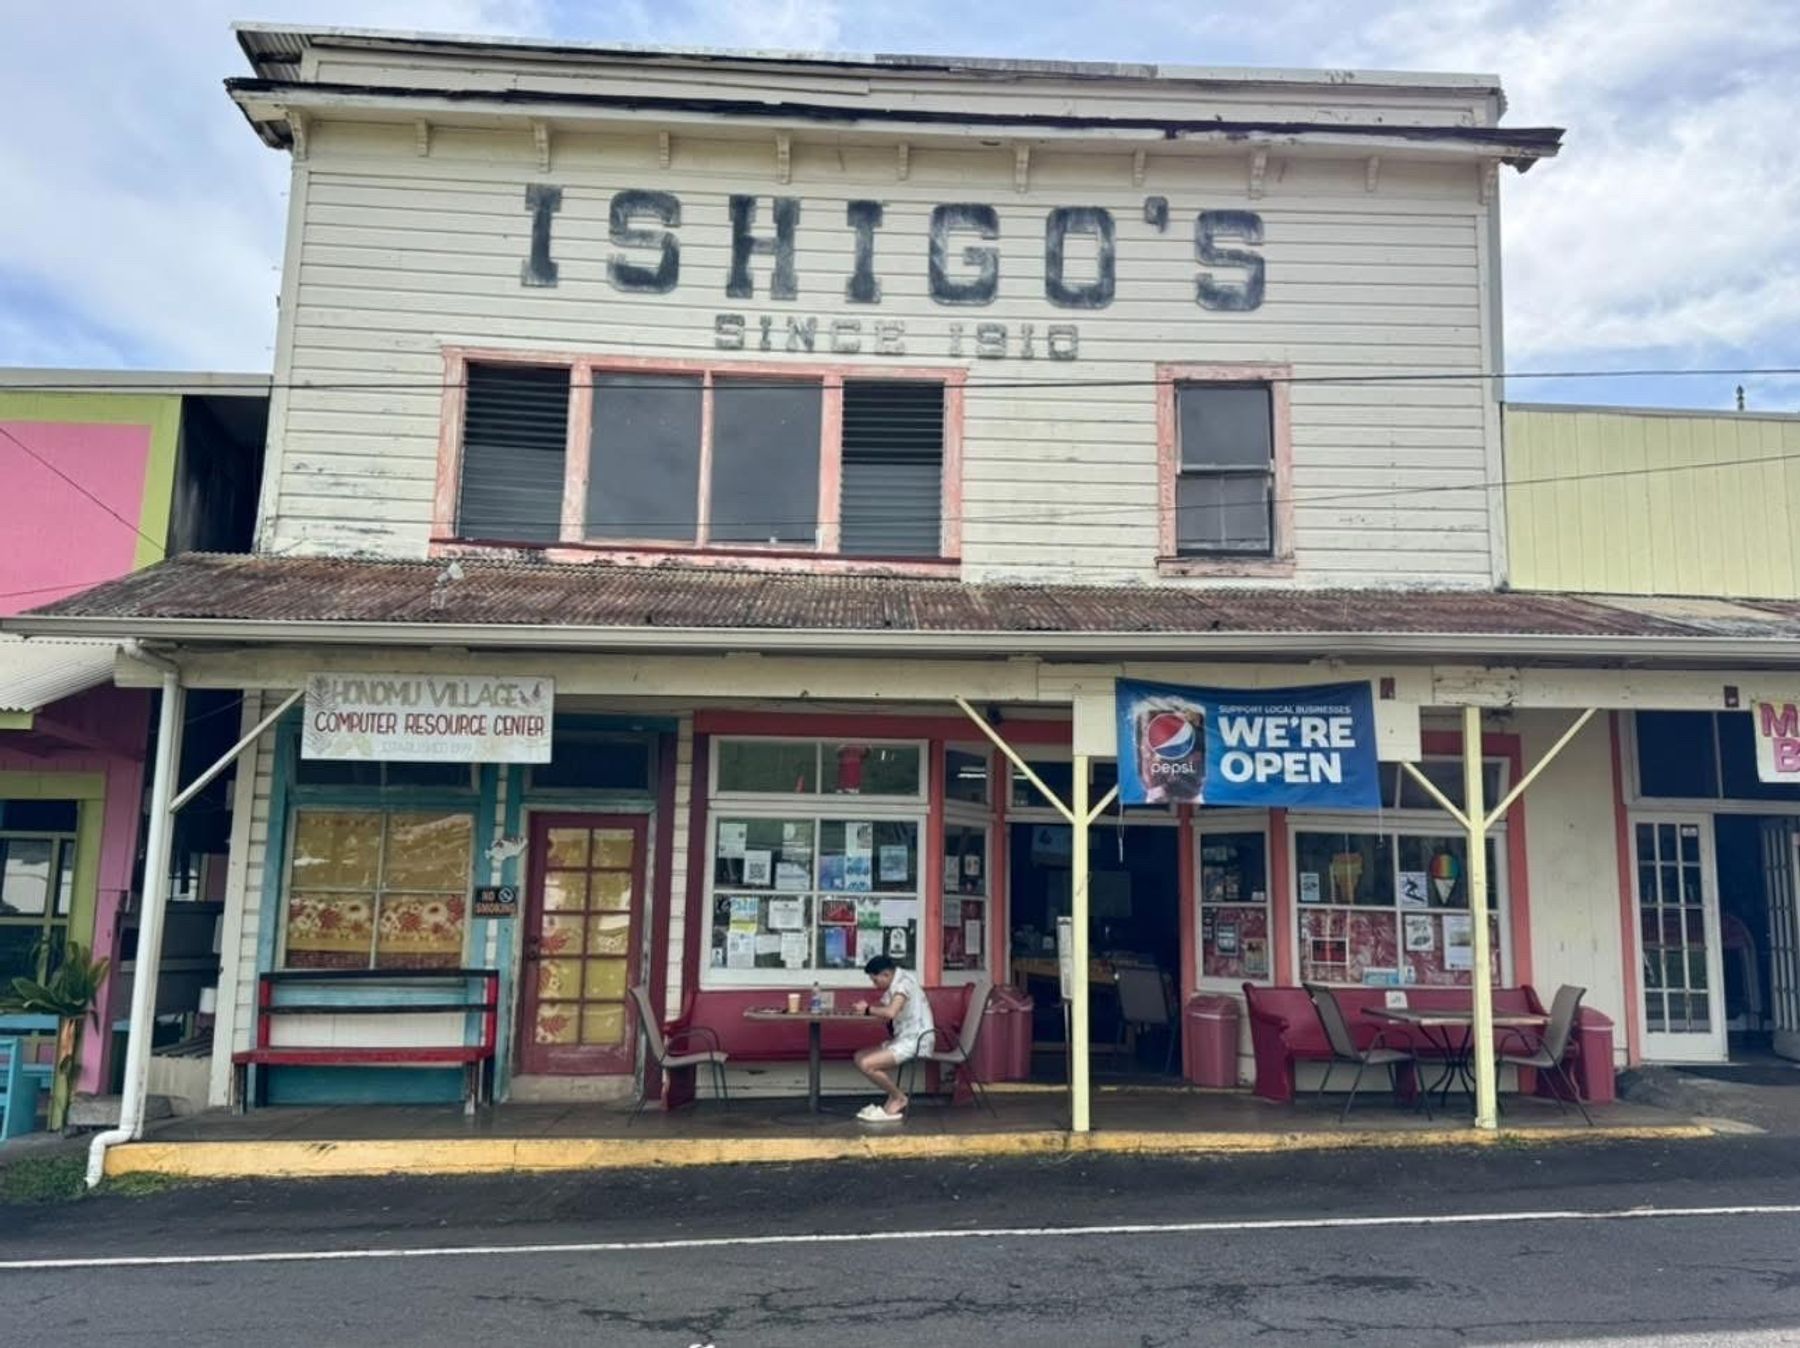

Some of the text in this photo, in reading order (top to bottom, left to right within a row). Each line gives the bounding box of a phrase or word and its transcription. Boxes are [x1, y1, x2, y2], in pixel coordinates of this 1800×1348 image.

[521, 183, 1267, 312] ISHIGO'S
[714, 314, 1079, 361] SINCE 1910
[332, 679, 518, 708] HONOMU VILLAGE
[314, 711, 545, 737] COMPUTER RESOURCE CENTER
[1218, 704, 1353, 714] SUPPORT LOCAL BUSINESSES
[1217, 716, 1356, 748] WE'RE
[1151, 761, 1195, 774] pepsi
[1220, 752, 1342, 783] OPEN
